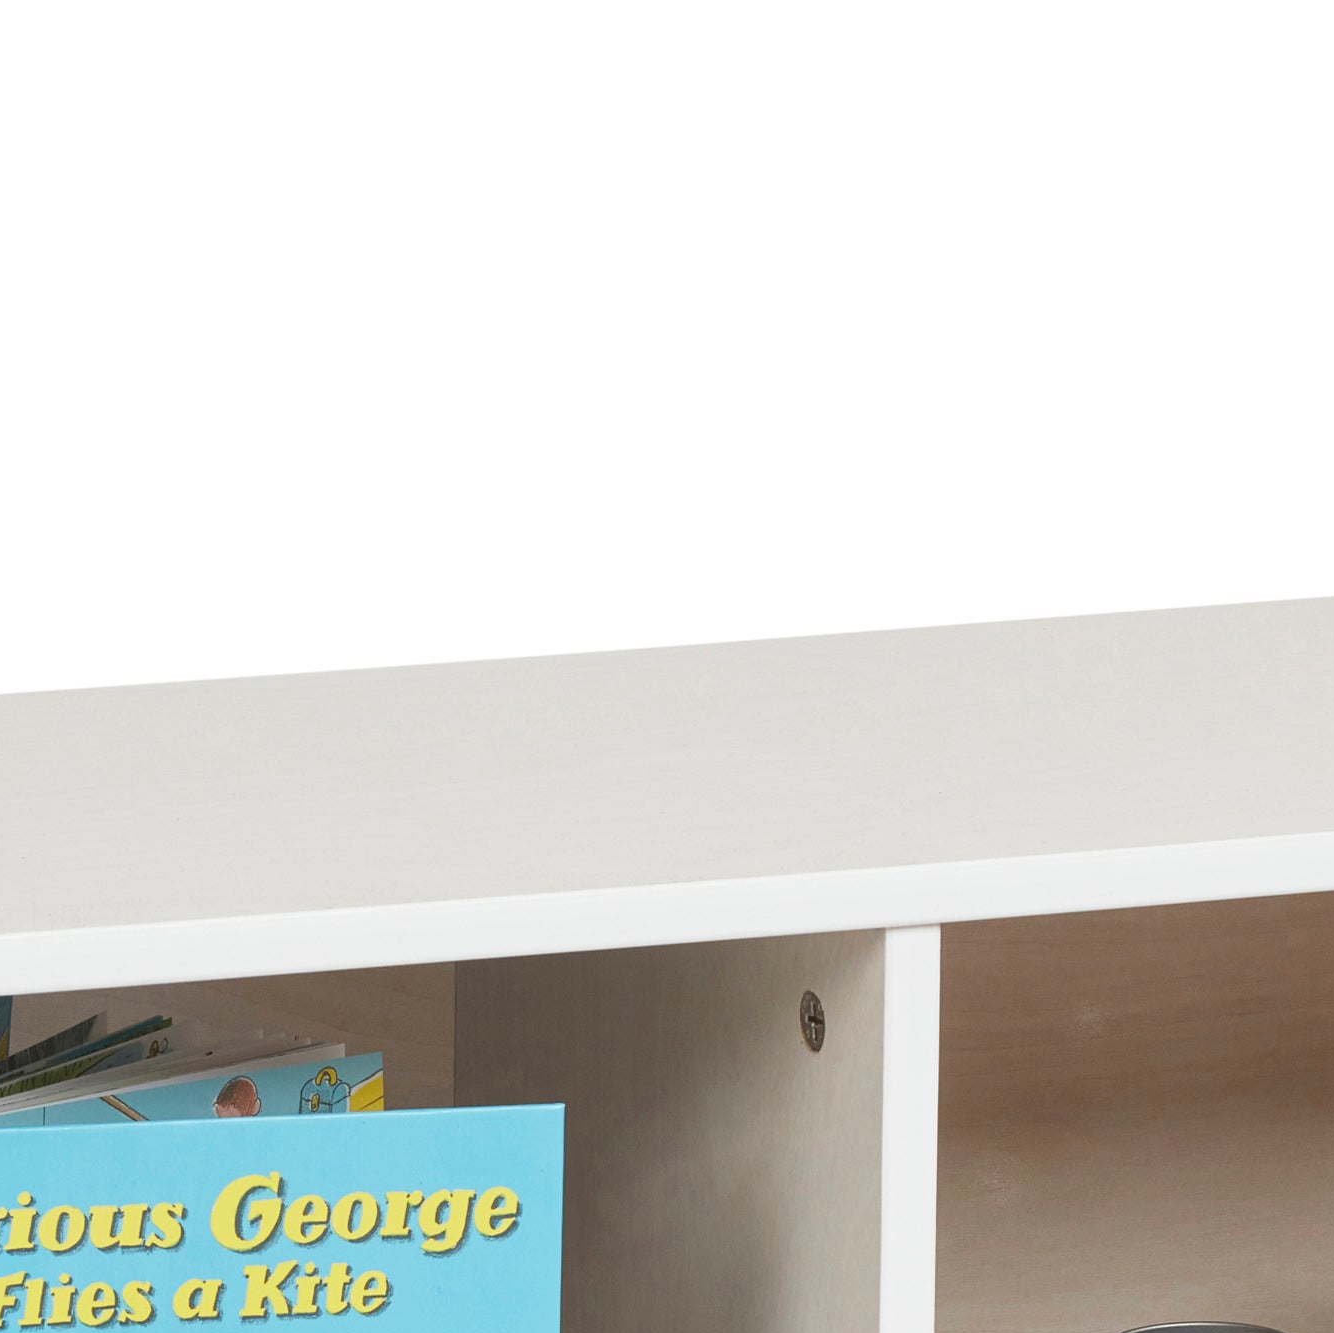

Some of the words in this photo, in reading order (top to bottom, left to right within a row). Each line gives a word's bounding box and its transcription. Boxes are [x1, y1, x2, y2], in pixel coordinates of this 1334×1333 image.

[210, 1171, 521, 1253] George
[172, 1278, 225, 1321] a
[239, 1260, 392, 1318] Kite
